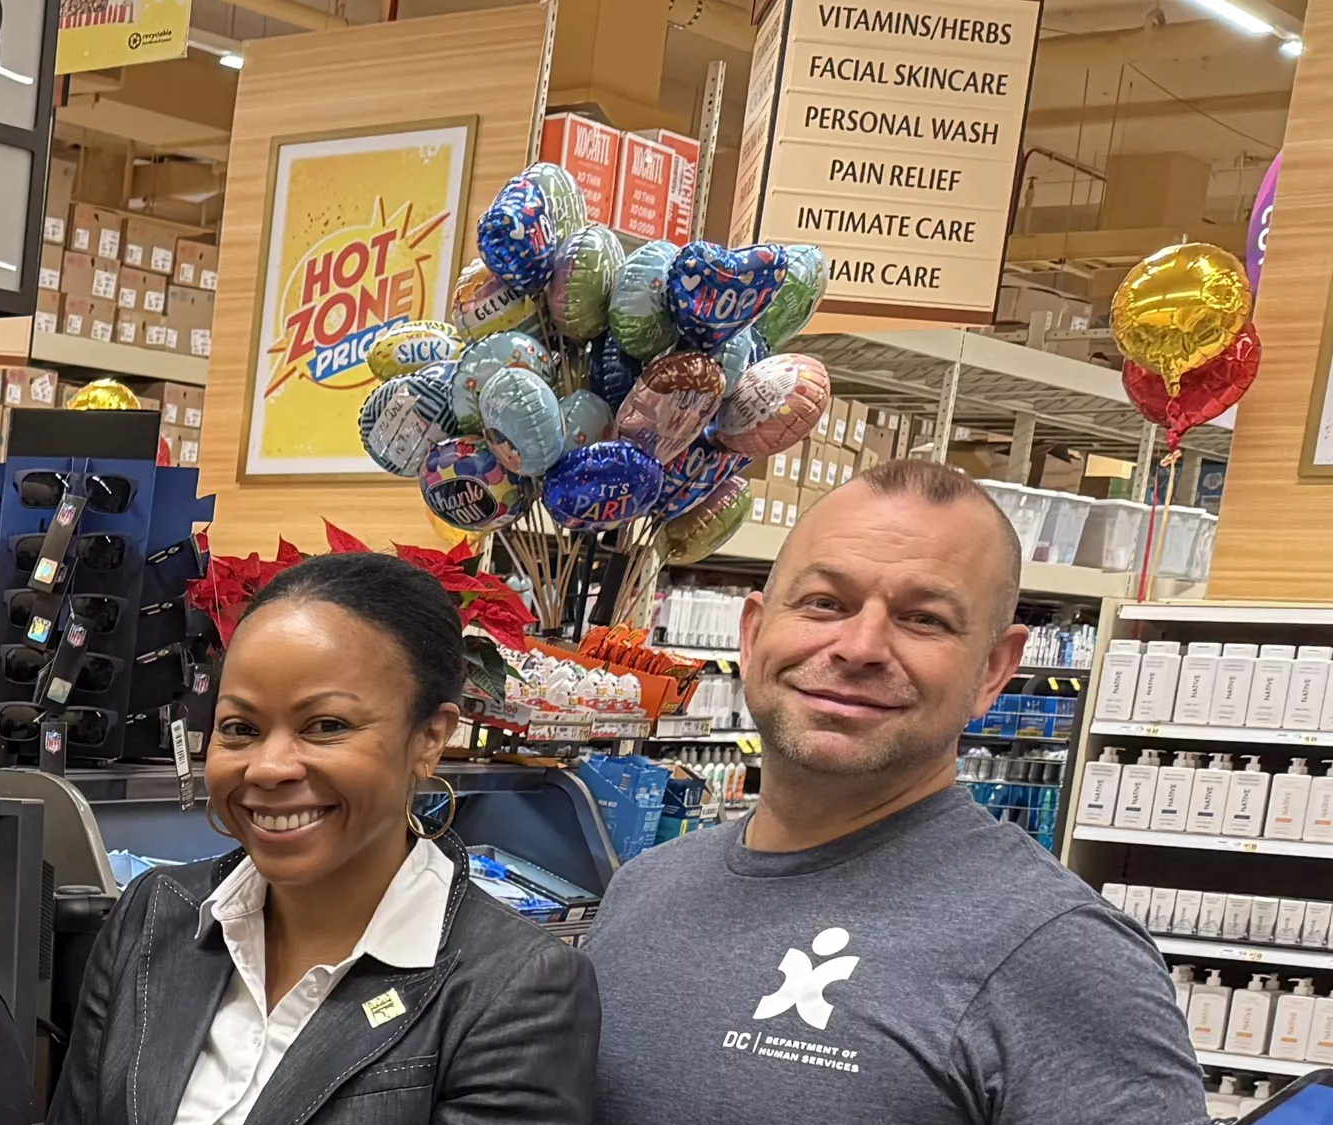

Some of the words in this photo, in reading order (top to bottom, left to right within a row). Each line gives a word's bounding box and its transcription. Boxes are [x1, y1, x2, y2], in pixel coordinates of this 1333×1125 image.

[818, 4, 1012, 45] VITAMINS/HERBS
[809, 55, 889, 84] FACIAL
[893, 63, 1009, 96] SKINCARE
[804, 105, 924, 138] PERSONAL
[931, 117, 999, 145] WASH
[829, 158, 884, 185] PAIN
[889, 165, 962, 192] RELIEF
[797, 206, 911, 237] INTIMATE
[915, 217, 976, 243] CARE
[302, 229, 397, 305] HOT
[829, 259, 875, 284] HAIR
[880, 263, 942, 289] CARE
[286, 268, 415, 364] ZONE
[397, 340, 451, 364] SICK!
[599, 482, 630, 498] IT'S
[573, 494, 640, 521] PARTY
[503, 703, 518, 714] 100
[722, 1030, 751, 1050] DC
[765, 1036, 839, 1057] DEPARTMENT
[841, 1049, 858, 1059] OF
[758, 1047, 799, 1061] HUMAN
[802, 1055, 860, 1073] SERVICES
